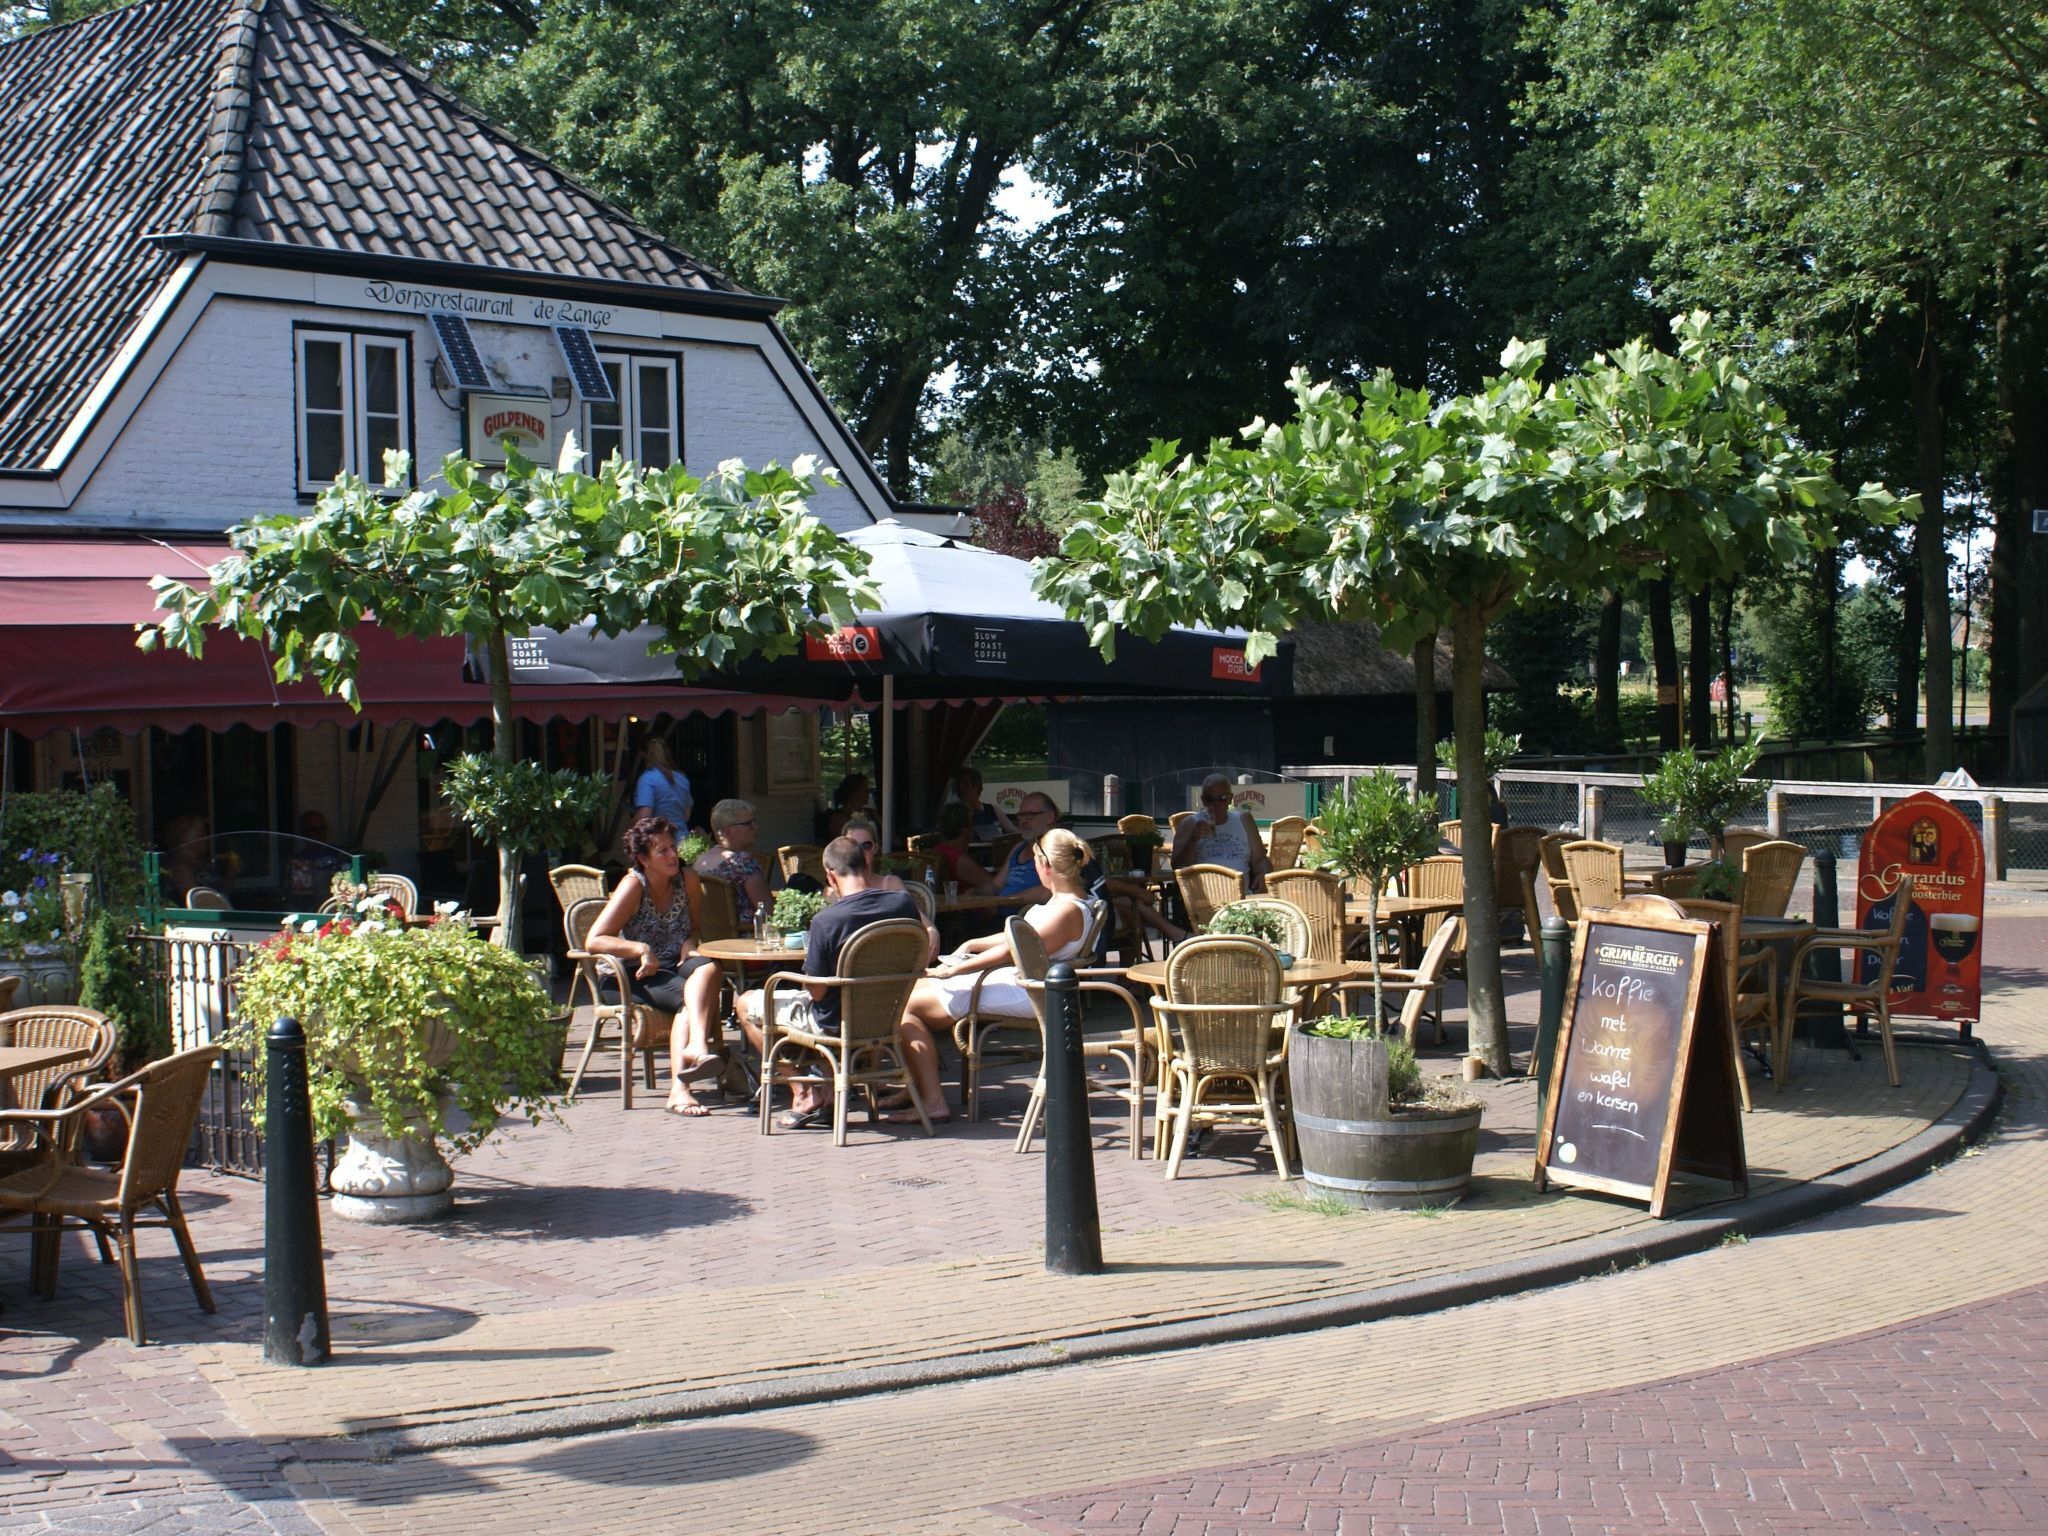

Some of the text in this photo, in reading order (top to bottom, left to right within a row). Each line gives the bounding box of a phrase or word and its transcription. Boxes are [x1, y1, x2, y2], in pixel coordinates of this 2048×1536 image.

[365, 280, 514, 316] Dorpsrestaurant
[484, 410, 544, 440] GULPENER
[975, 632, 997, 640] SLOW
[512, 641, 538, 650] SLOW
[975, 641, 1001, 650] ROAST
[512, 649, 543, 658] ROAST
[975, 650, 1007, 660] COFFEE
[1219, 655, 1244, 665] MOCCA
[513, 657, 550, 666] COFFEE
[1234, 790, 1265, 808] GULPENER
[1600, 946, 1679, 968] GRIMBERGEN
[1600, 1013, 1627, 1032] met
[1590, 1069, 1631, 1092] wafel
[1577, 1090, 1639, 1115] en kersen
